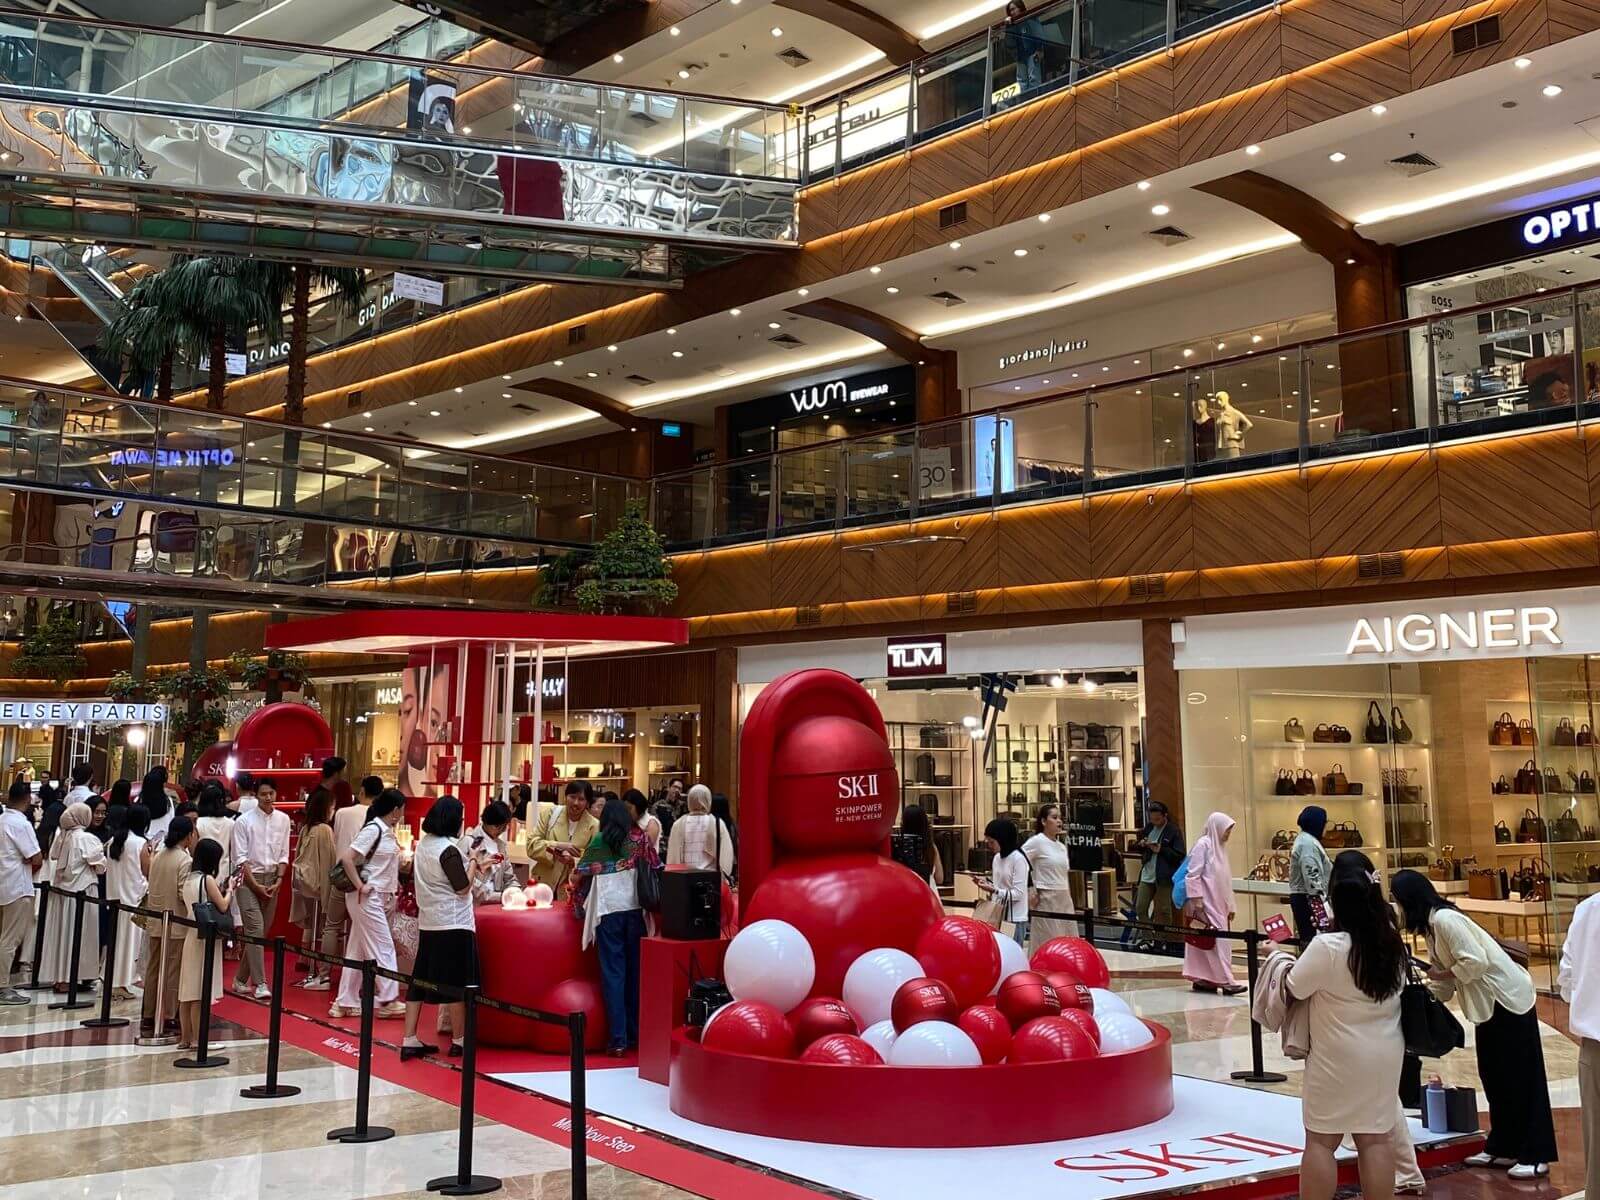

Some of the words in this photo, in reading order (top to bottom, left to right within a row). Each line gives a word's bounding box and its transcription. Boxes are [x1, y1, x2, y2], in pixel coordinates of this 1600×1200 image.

[1431, 295, 1453, 308] BOSS
[850, 384, 888, 401] EYEWEAR
[919, 466, 946, 489] 30
[1344, 606, 1563, 655] AIGNER
[2, 703, 79, 719] ELSEY
[92, 704, 163, 719] PARIS
[838, 774, 880, 799] SK-II
[835, 803, 882, 815] SKINPOWER
[862, 812, 882, 821] CREAM
[1065, 835, 1102, 848] ALPHA
[604, 1136, 636, 1155] Step
[1053, 1131, 1304, 1184] SK-II
